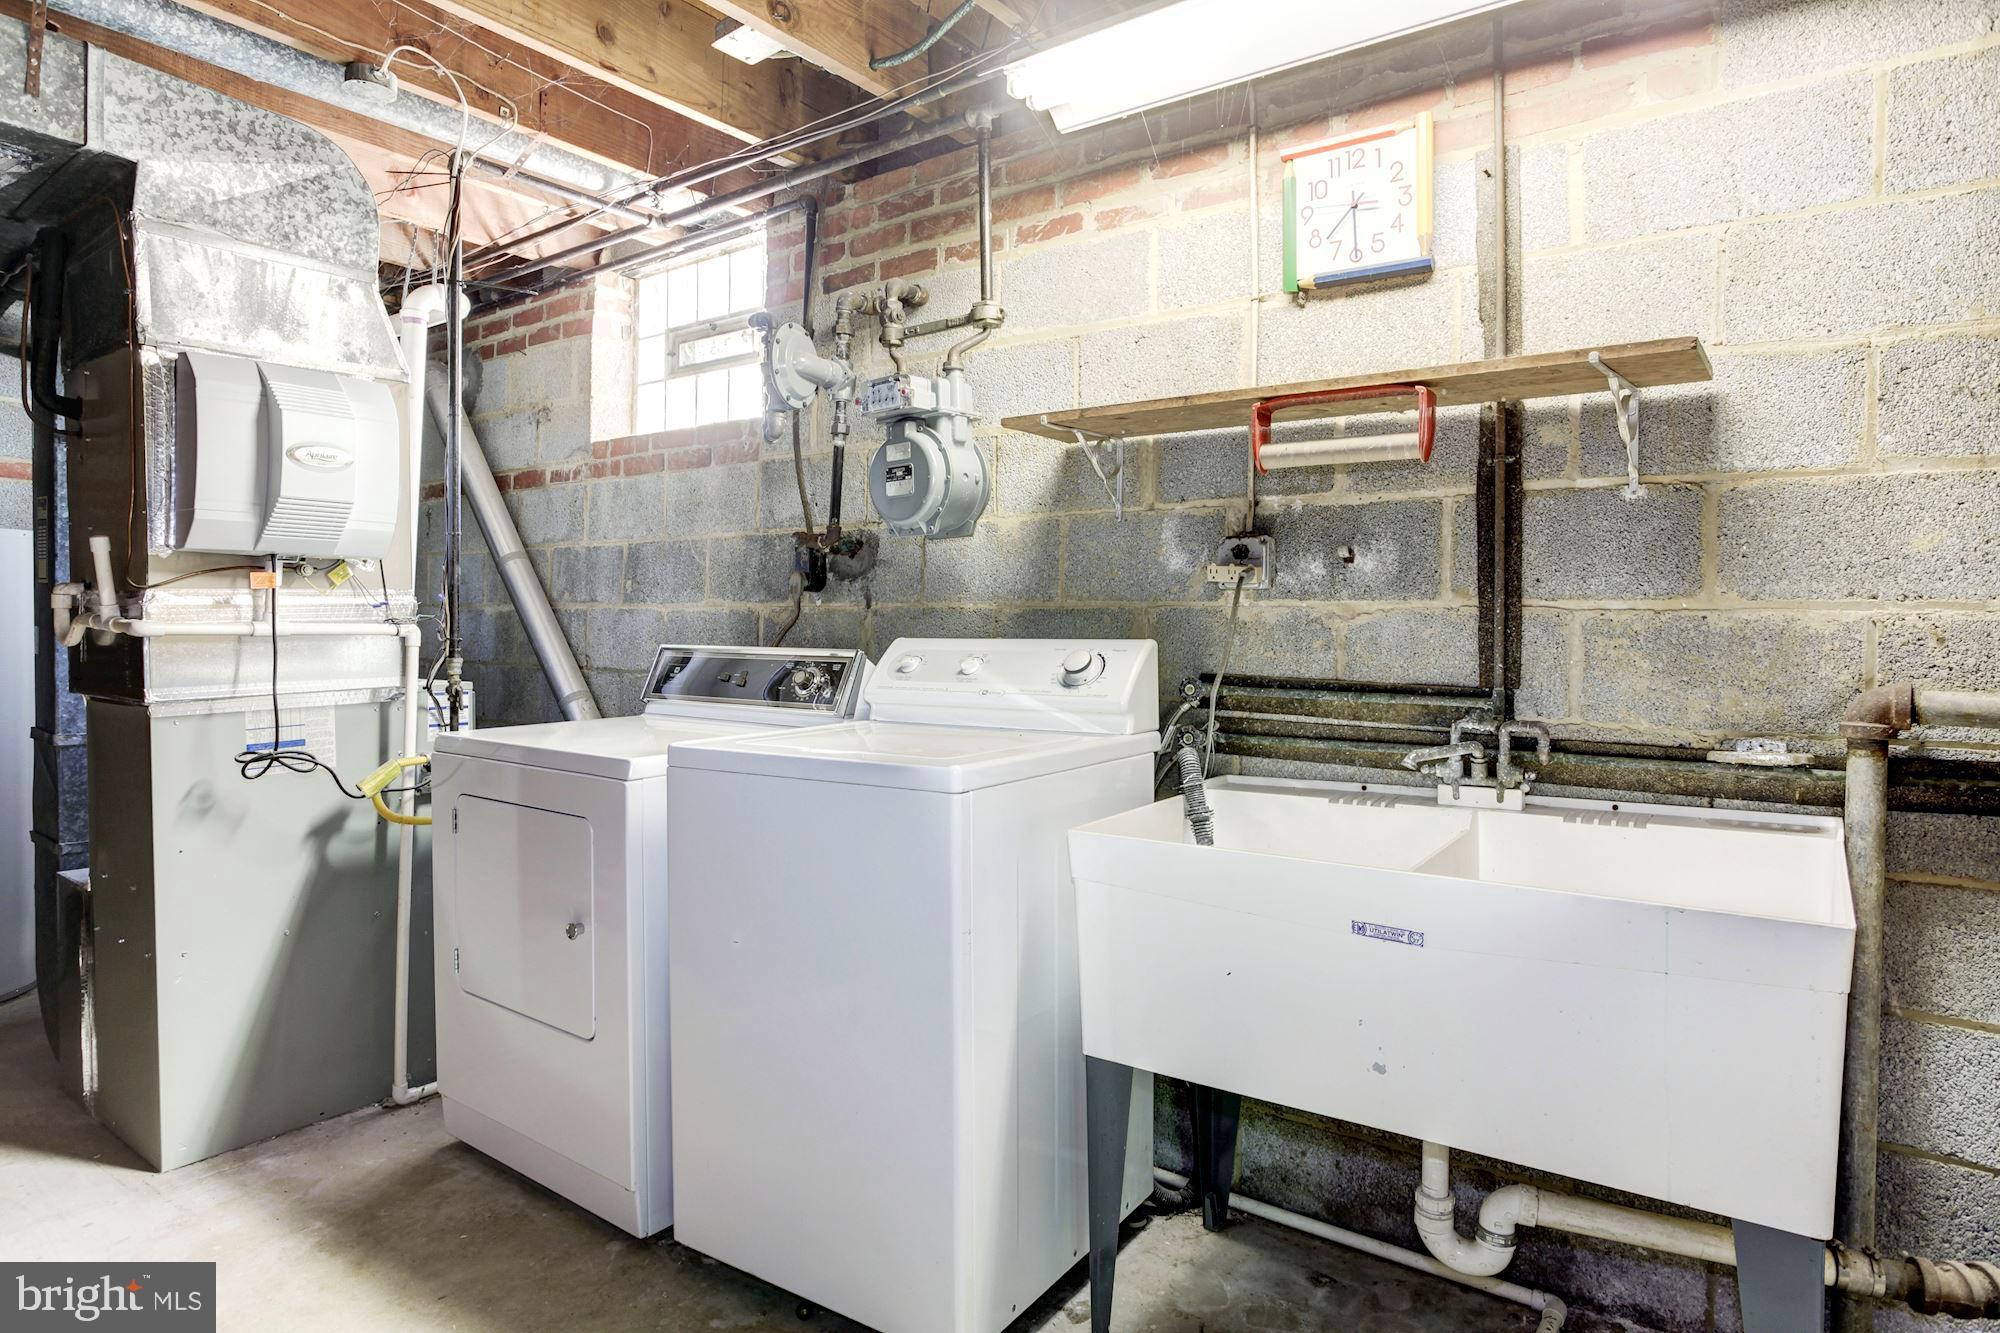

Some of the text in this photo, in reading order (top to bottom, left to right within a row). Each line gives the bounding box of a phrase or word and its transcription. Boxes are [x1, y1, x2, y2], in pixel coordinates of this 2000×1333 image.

[1328, 157, 1341, 178] 11
[1345, 147, 1366, 170] 12
[1375, 147, 1381, 168] 1
[1390, 161, 1404, 183] 2
[1308, 179, 1328, 201] 10
[1398, 185, 1413, 206] 3
[1300, 205, 1314, 226] 9
[1390, 212, 1404, 233] 4
[1309, 228, 1322, 249] 8
[1371, 232, 1385, 253] 5
[1329, 239, 1342, 261] 7
